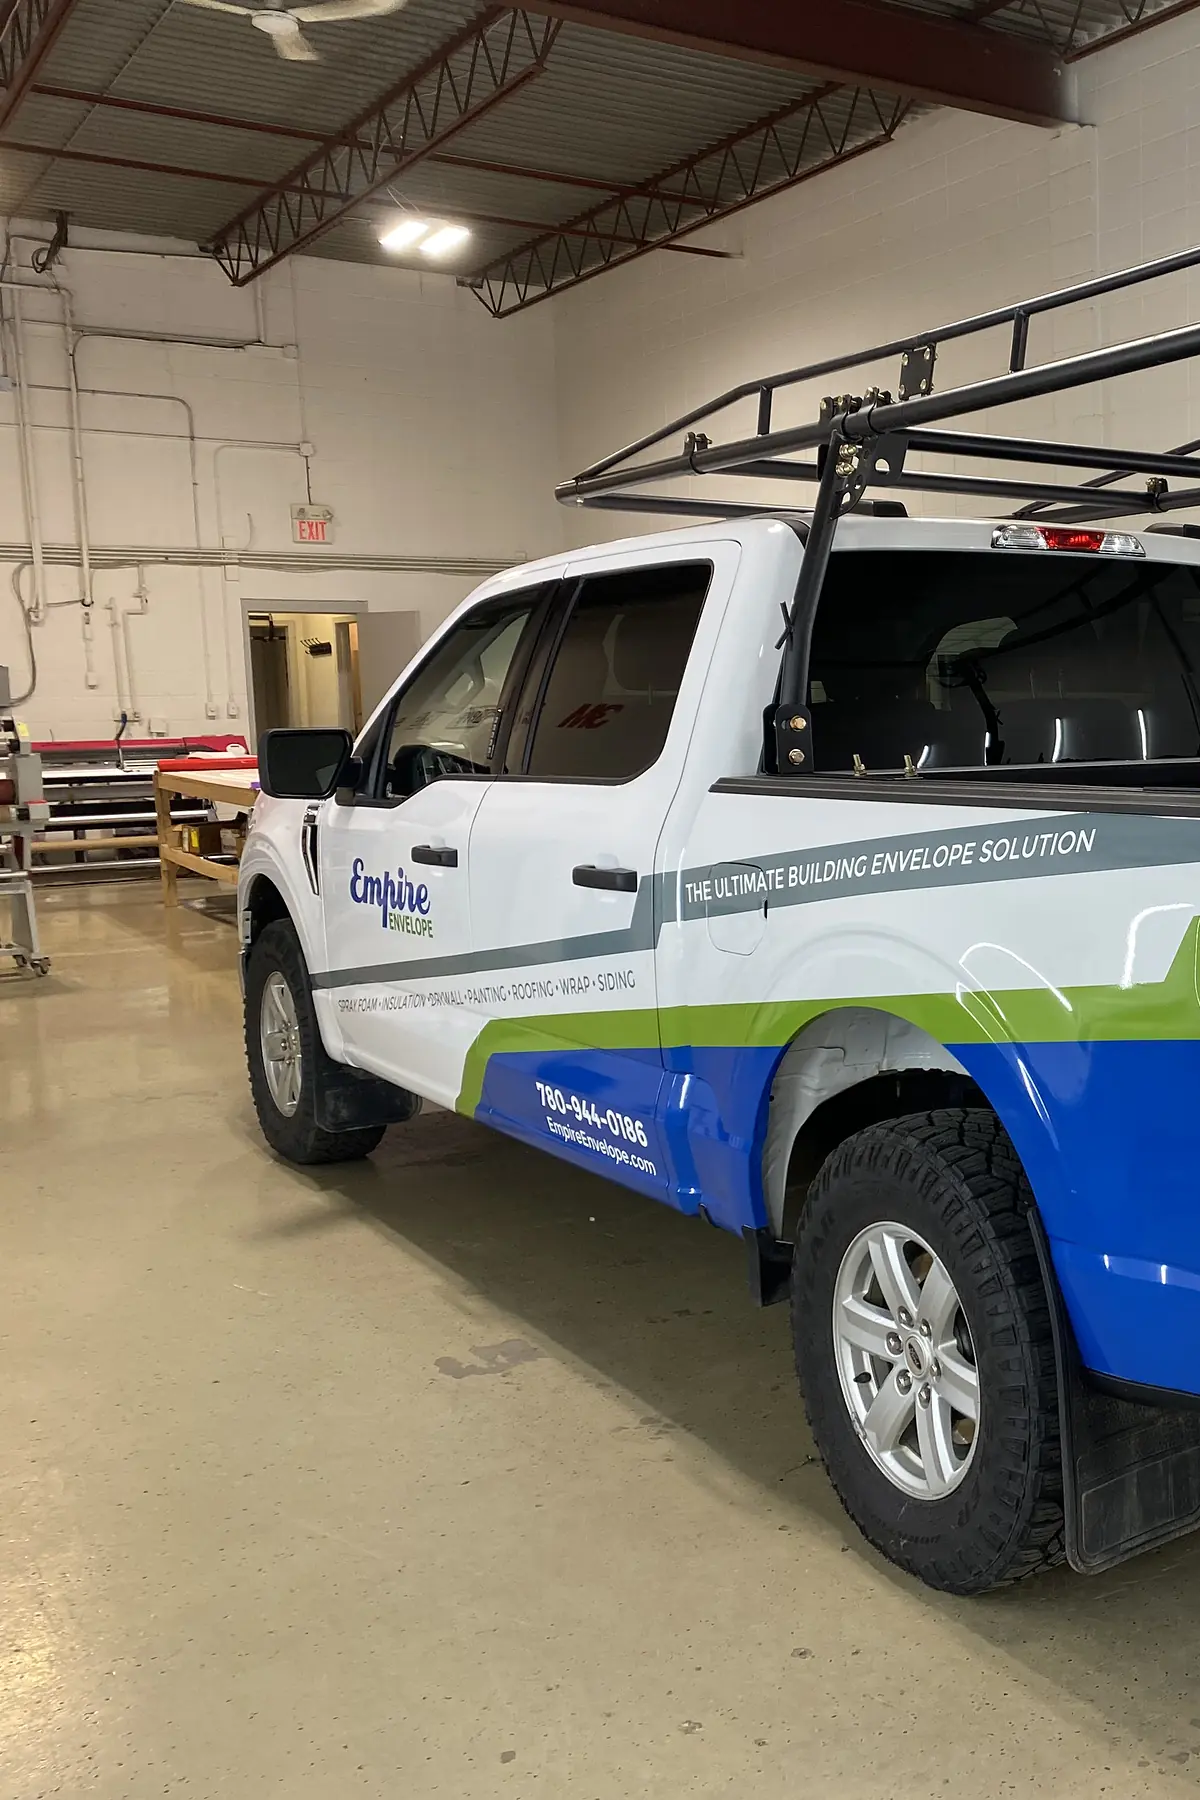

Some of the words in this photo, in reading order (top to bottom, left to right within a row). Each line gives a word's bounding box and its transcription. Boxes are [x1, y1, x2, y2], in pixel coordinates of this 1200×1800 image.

[298, 520, 327, 541] EXIT
[350, 858, 430, 928] Empire
[685, 879, 713, 904] THE
[714, 867, 785, 898] ULTIMATE
[788, 854, 867, 888] BUILDING
[870, 841, 977, 876] ENVELOPE
[979, 828, 1097, 864] SOLUTION
[388, 912, 434, 939] ENVELOPE
[338, 999, 358, 1013] SPRAY
[358, 998, 378, 1012] FOAM
[381, 993, 426, 1011] INSULATION
[429, 990, 464, 1007] DRYWALL
[467, 985, 507, 1004] PAINTING
[512, 980, 554, 1000] ROOFING
[559, 975, 590, 996] WRAP
[598, 970, 636, 992] SIDING
[535, 1081, 648, 1148] 780-944-0186
[546, 1116, 657, 1176] EmpireEnvelope.com
